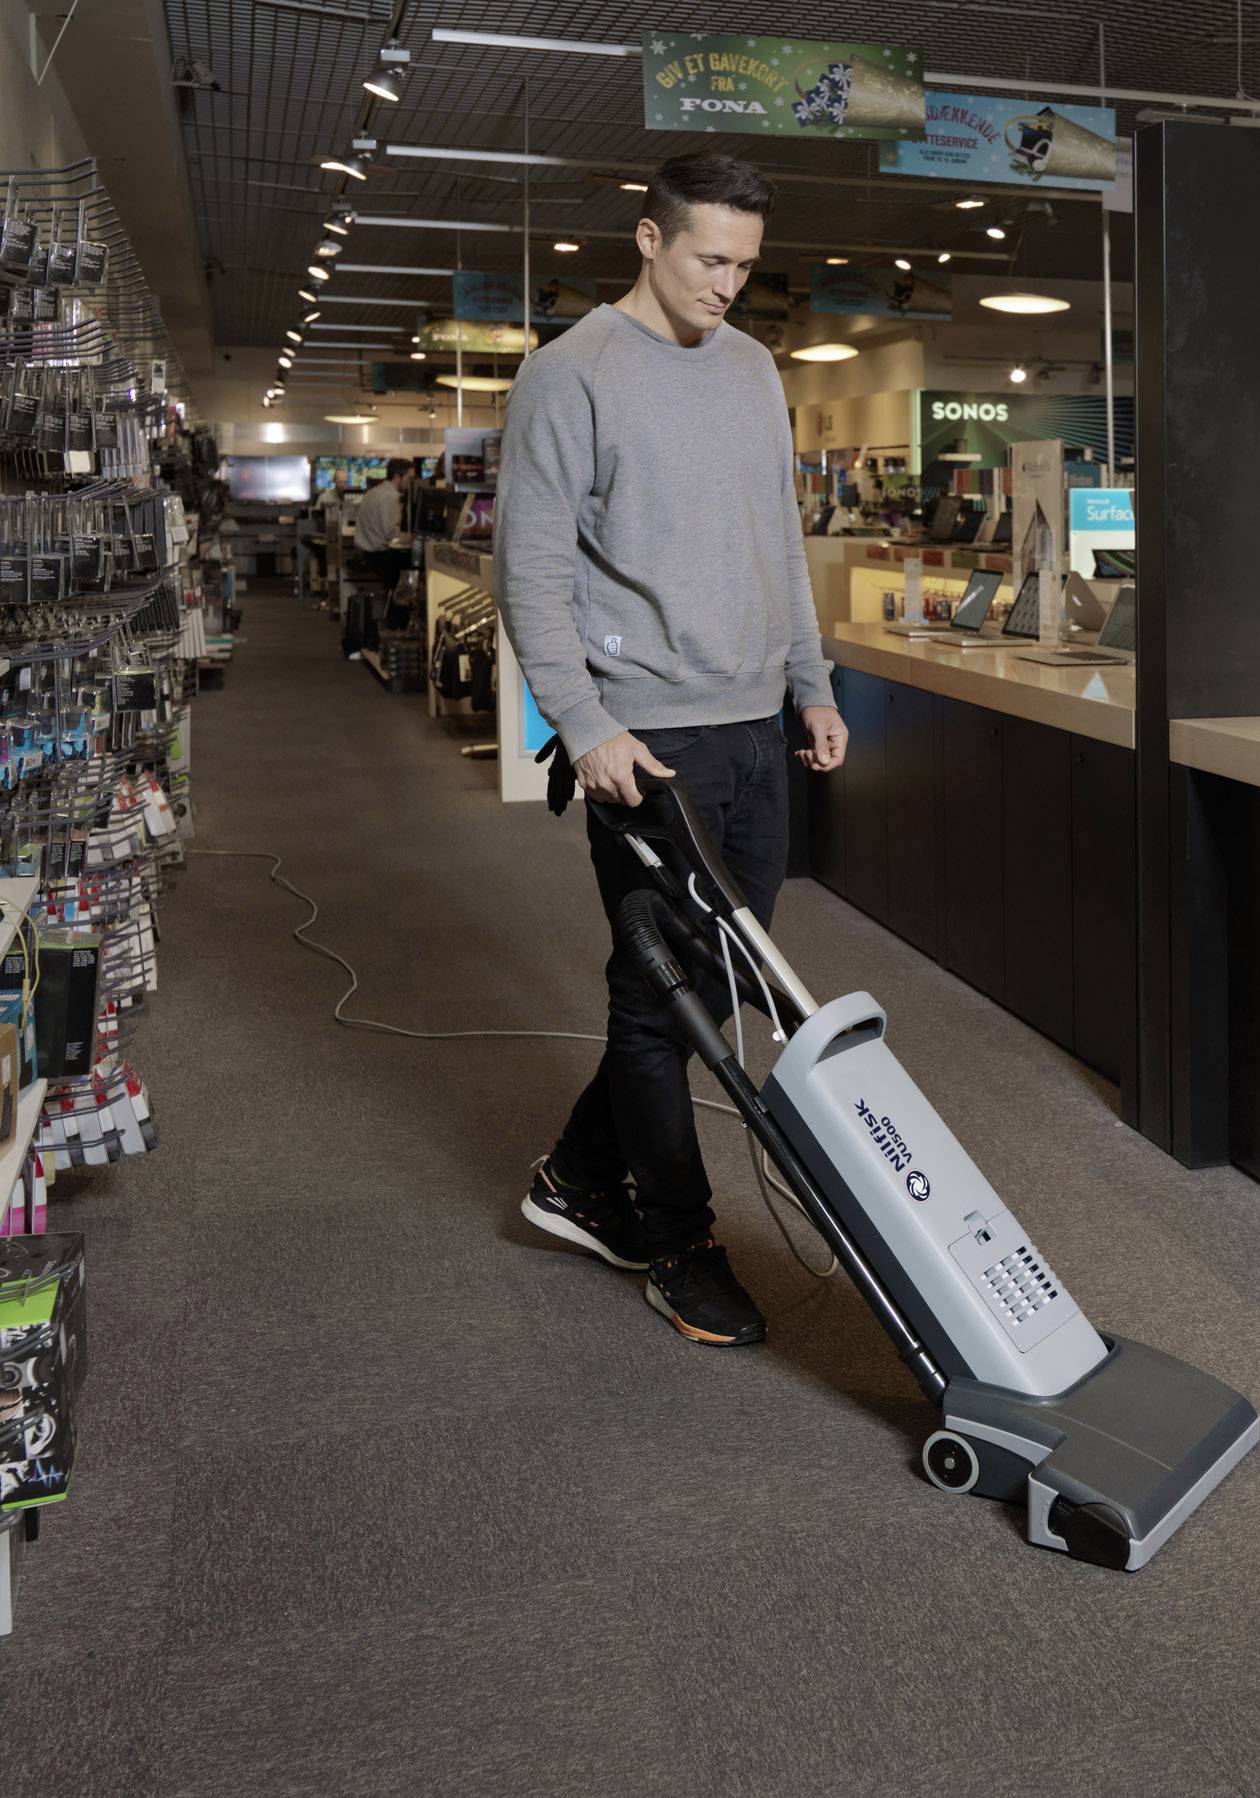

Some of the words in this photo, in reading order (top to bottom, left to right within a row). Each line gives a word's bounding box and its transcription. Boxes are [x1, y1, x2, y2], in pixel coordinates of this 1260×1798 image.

[656, 61, 684, 88] GIV
[684, 53, 704, 75] ET
[708, 52, 789, 92] GAVEKORT
[710, 76, 734, 92] FRA
[680, 98, 767, 114] FONA
[932, 402, 1009, 421] SONOS
[1087, 505, 1134, 521] Surfac
[854, 1098, 905, 1172] Nilfisk
[881, 1116, 912, 1164] VU500
